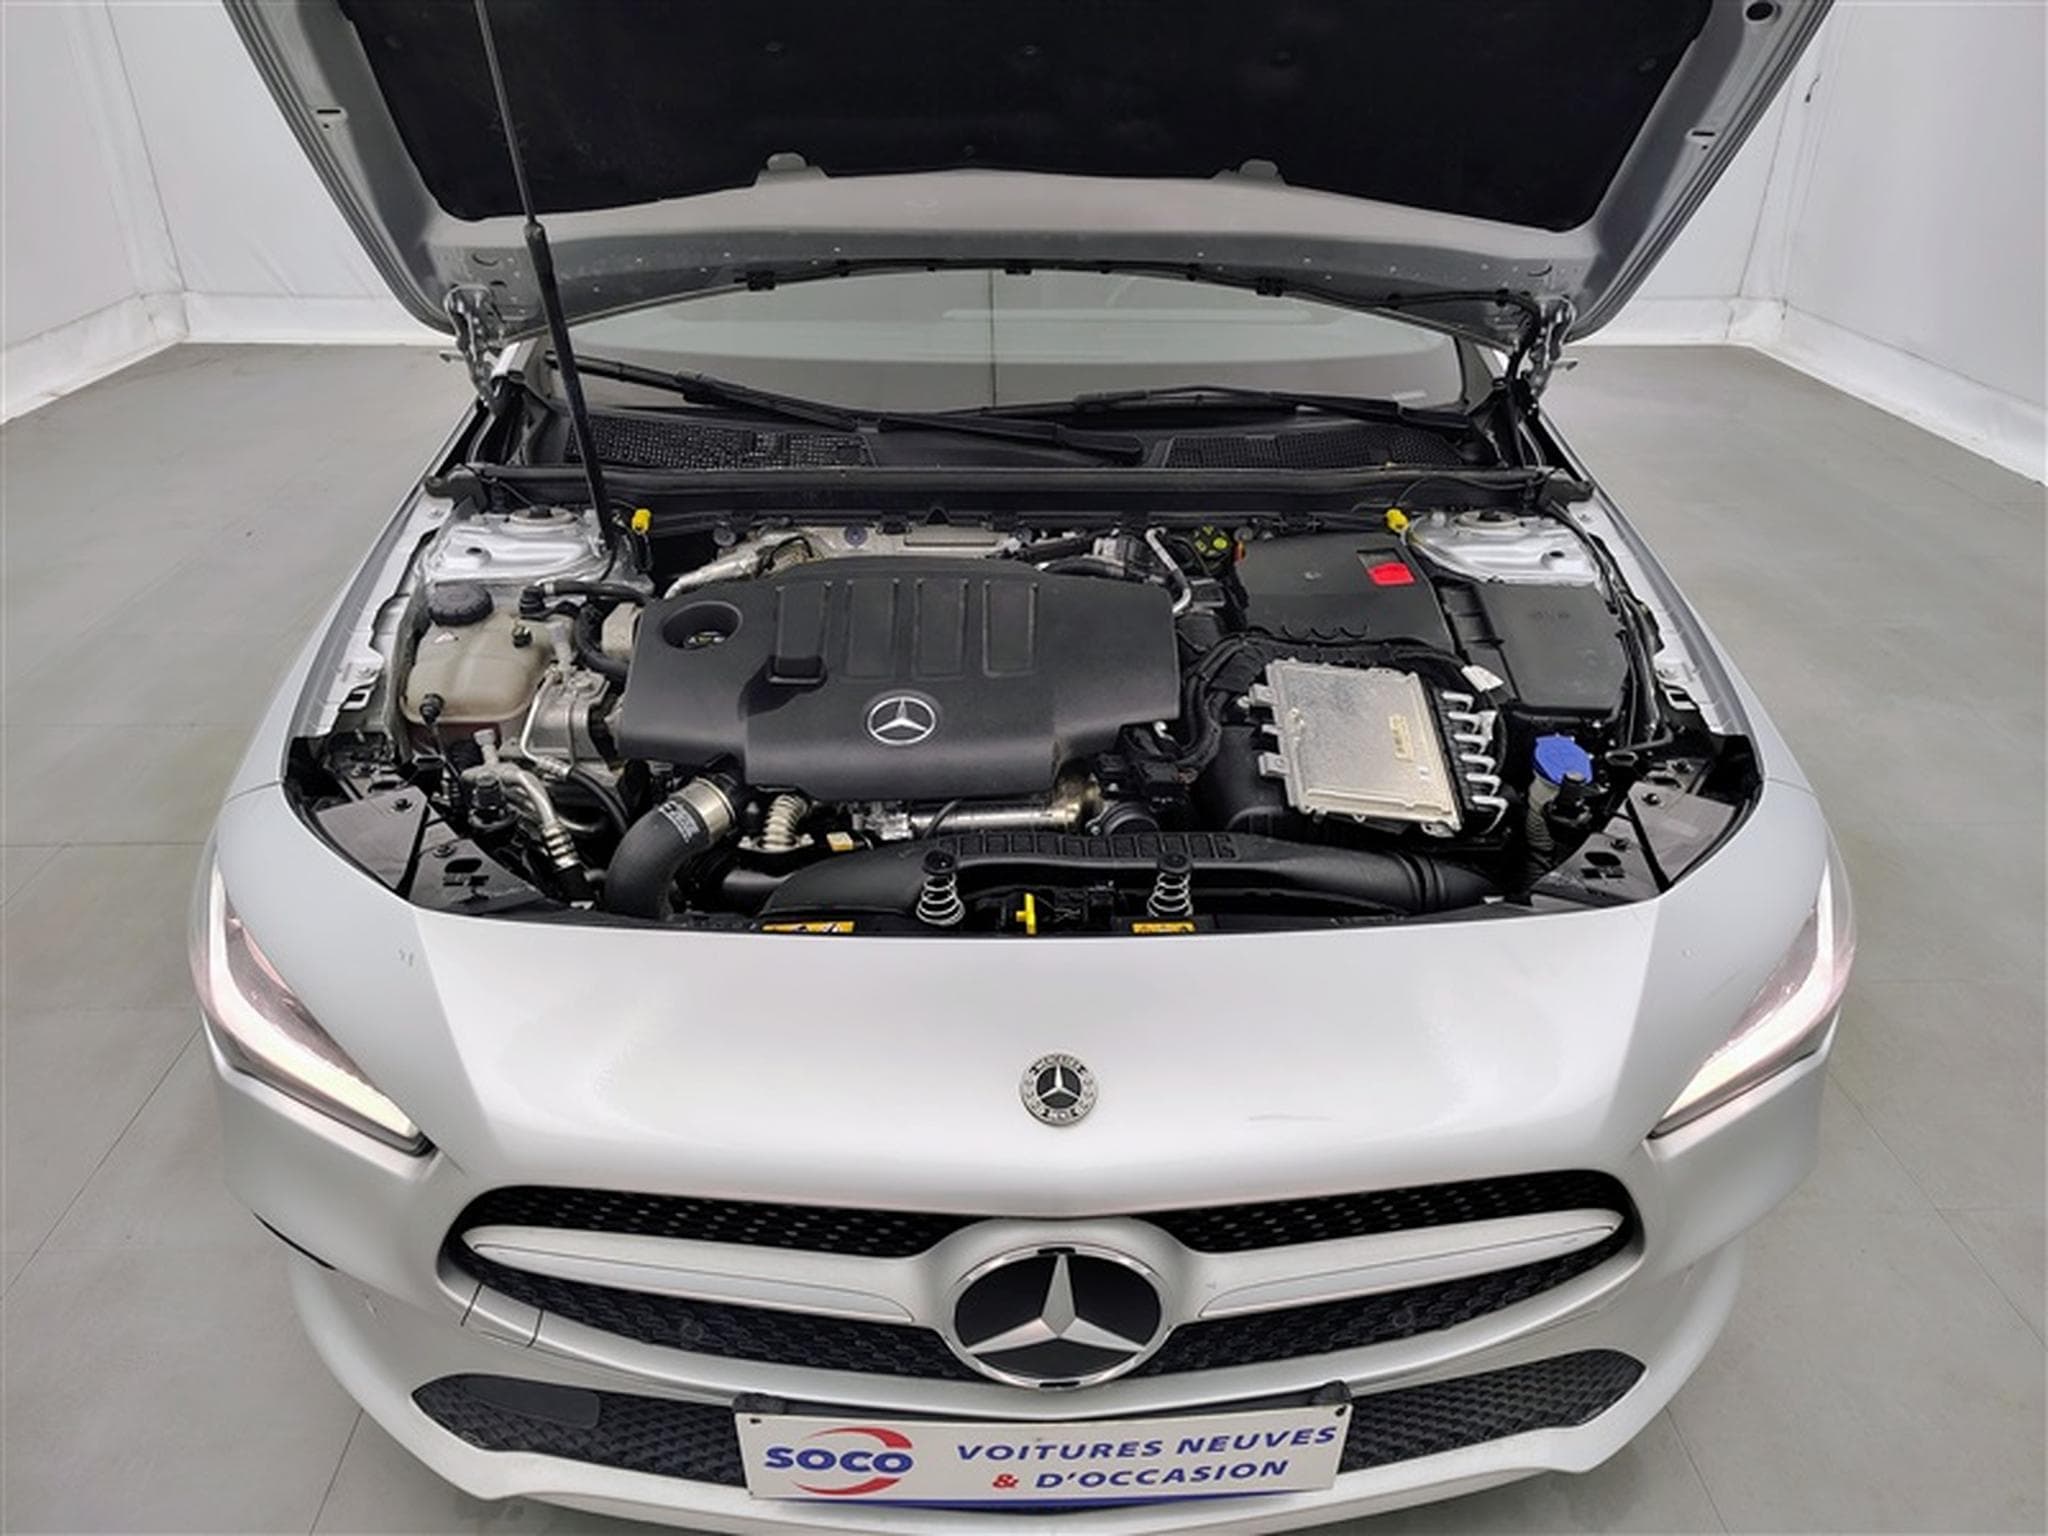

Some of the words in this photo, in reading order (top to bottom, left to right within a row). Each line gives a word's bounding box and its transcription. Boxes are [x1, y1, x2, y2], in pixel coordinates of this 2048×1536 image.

[957, 1440, 1162, 1462] VOITURES
[1175, 1425, 1338, 1455] NEUVES
[765, 1446, 914, 1475] SOCO
[992, 1473, 1019, 1489] &
[1034, 1459, 1290, 1488] D'OCCASION
